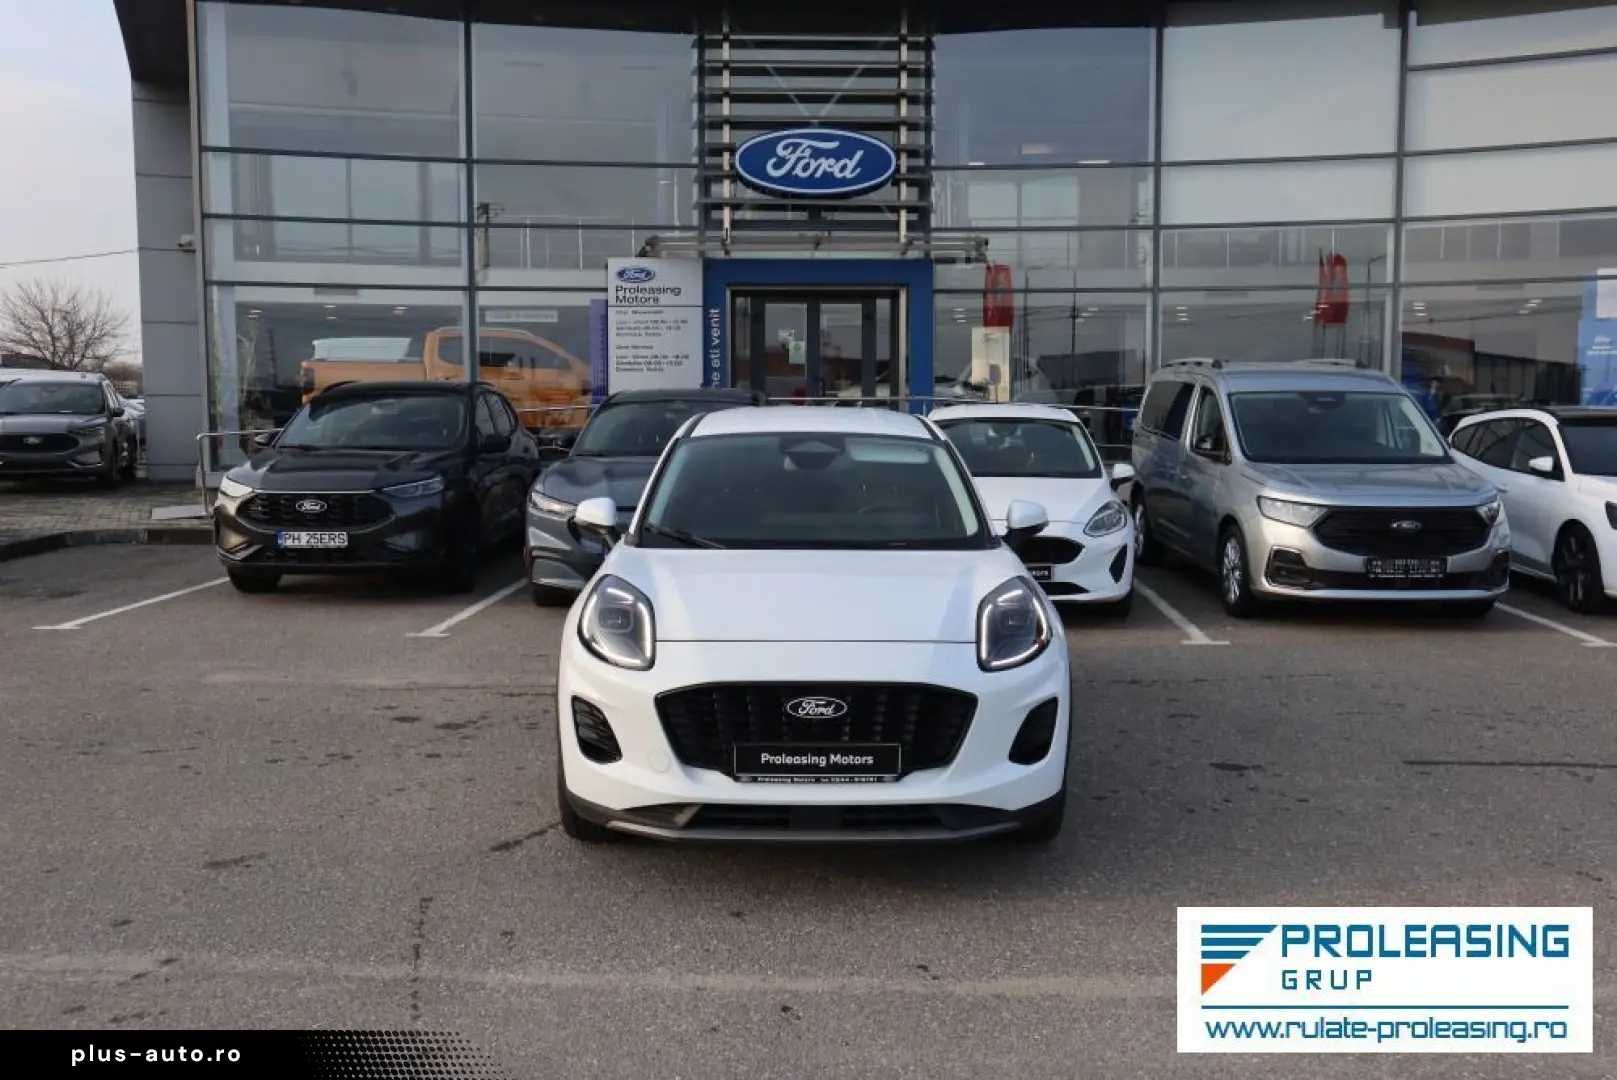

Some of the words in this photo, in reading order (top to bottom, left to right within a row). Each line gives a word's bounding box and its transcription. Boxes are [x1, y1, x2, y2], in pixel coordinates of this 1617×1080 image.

[766, 138, 864, 179] Ford
[615, 285, 682, 297] Proleasing
[615, 295, 660, 305] Motors
[708, 307, 721, 347] venit
[284, 532, 301, 544] PH
[760, 752, 827, 767] Proleasing
[829, 752, 874, 765] Motors
